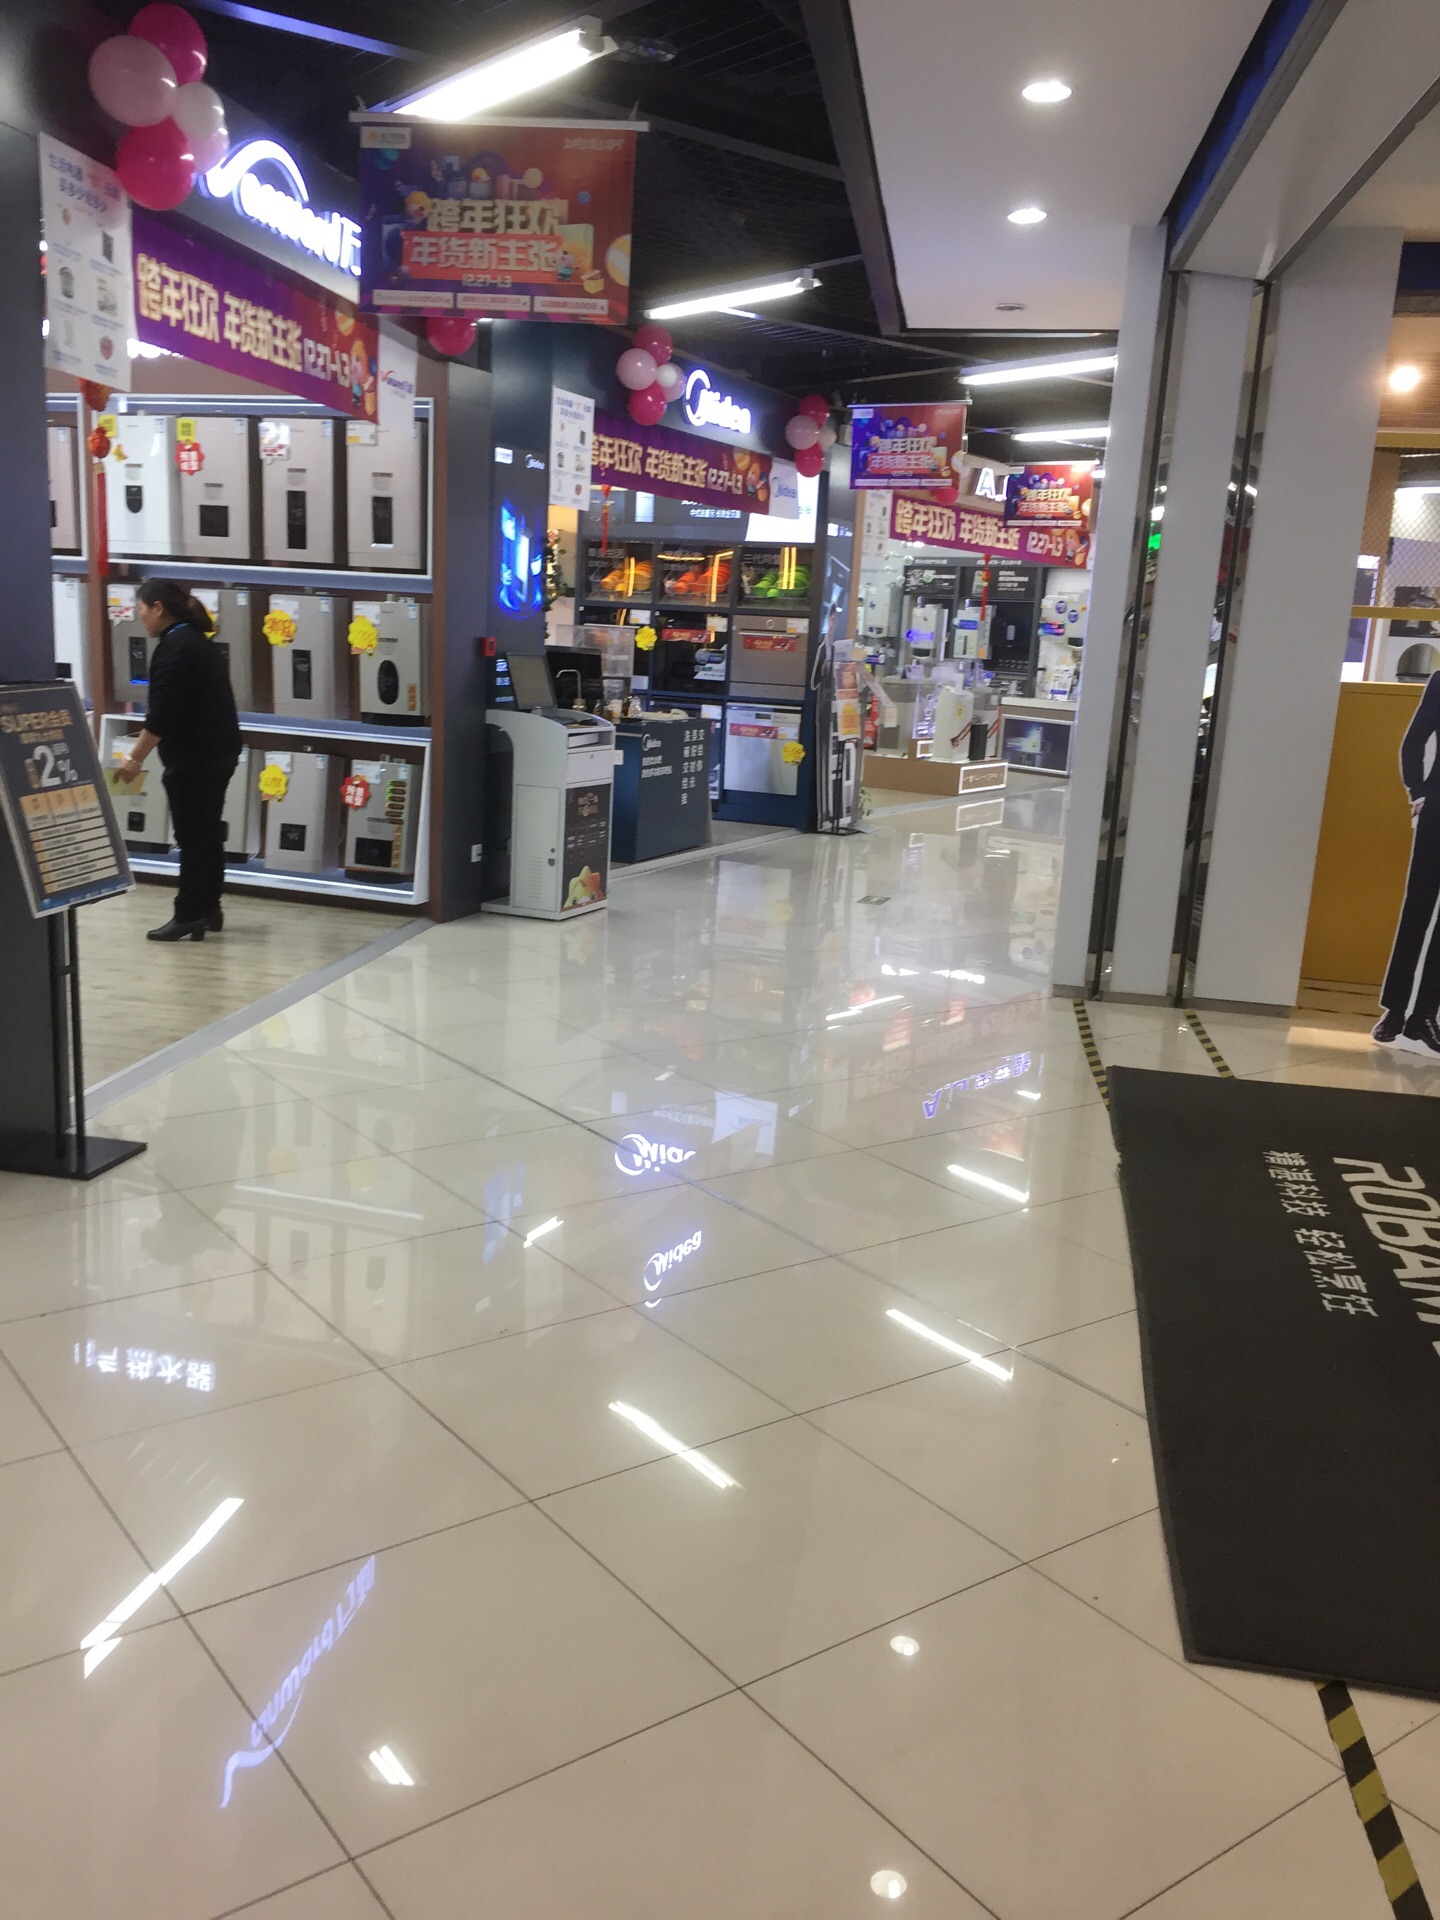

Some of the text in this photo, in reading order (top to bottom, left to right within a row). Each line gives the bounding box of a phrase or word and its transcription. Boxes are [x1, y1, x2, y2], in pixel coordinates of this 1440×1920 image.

[426, 198, 567, 236] 跨年狂欢
[409, 235, 560, 274] 年货新主张
[136, 253, 221, 344] 跨年狂欢
[222, 290, 304, 373] 年货新主张
[683, 369, 751, 434] Midea
[645, 446, 709, 489] 年货新主张
[894, 498, 957, 541] 跨年狂欢
[1262, 1150, 1379, 1318] 精湛科技 轻松烹饪
